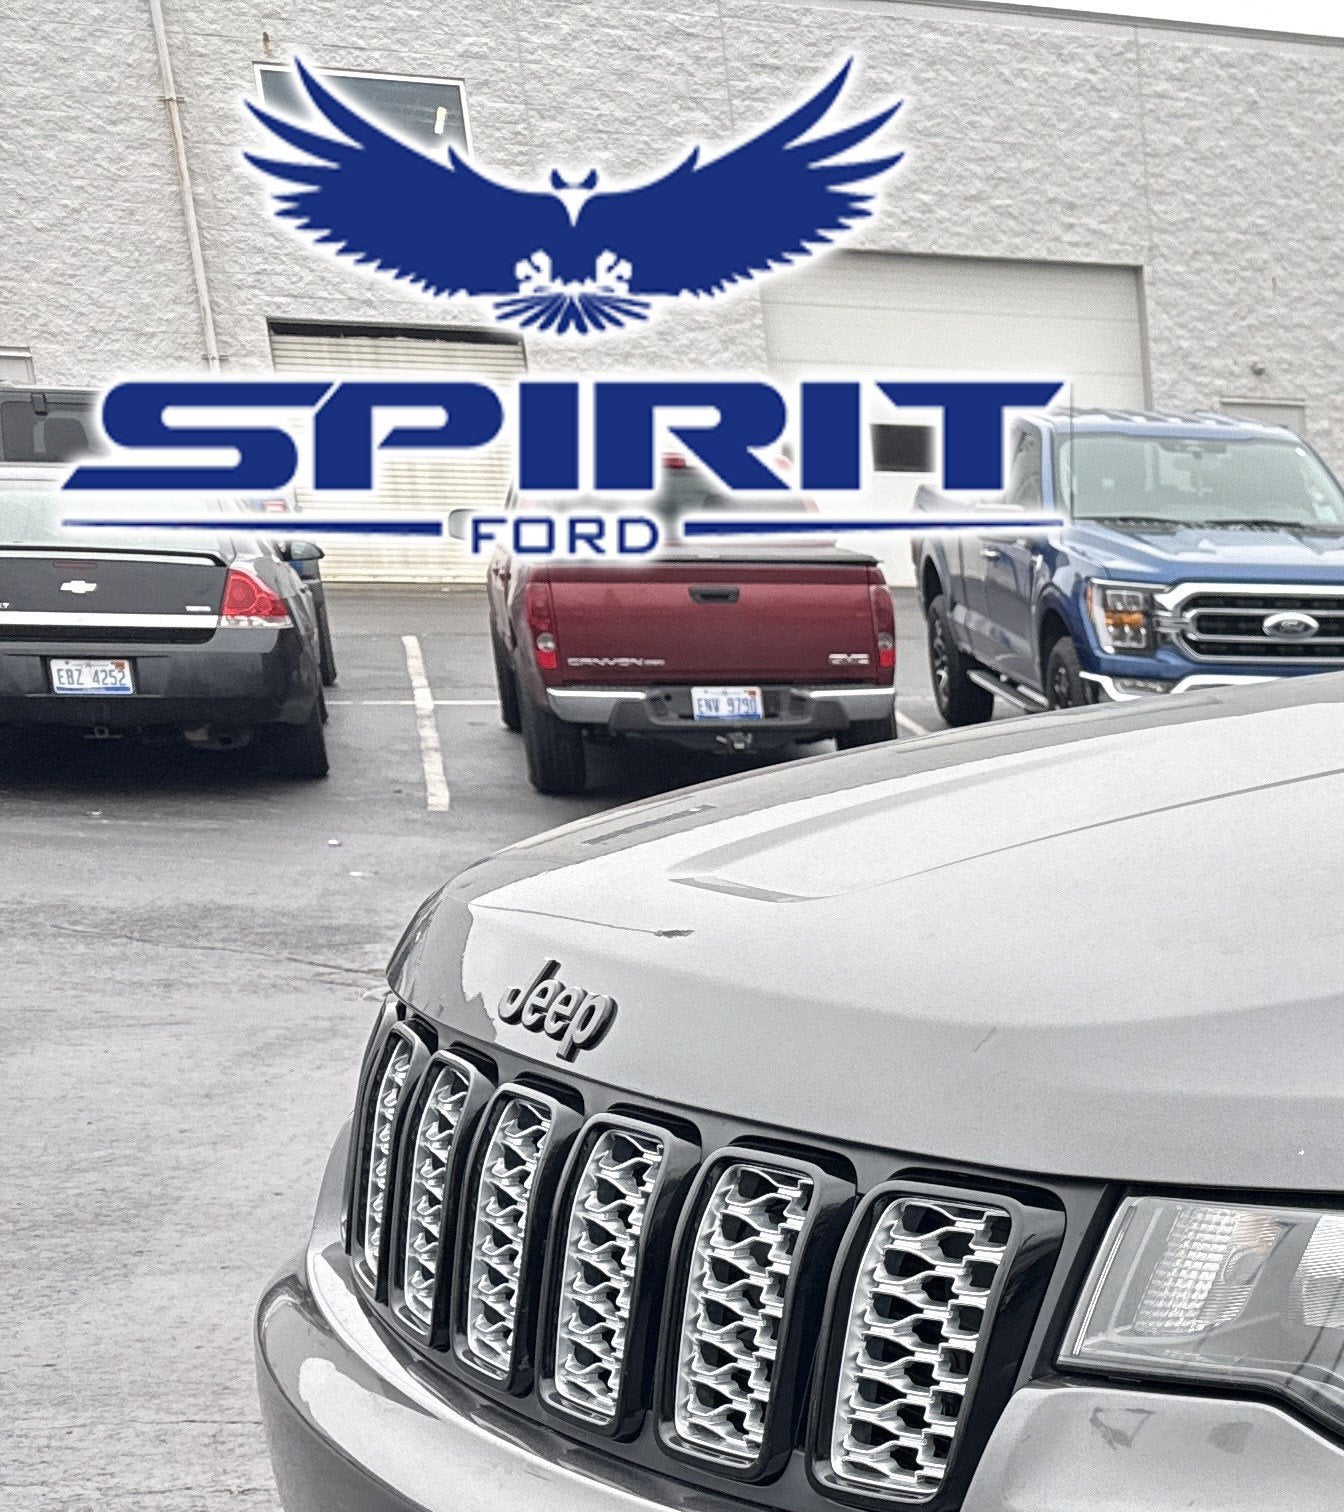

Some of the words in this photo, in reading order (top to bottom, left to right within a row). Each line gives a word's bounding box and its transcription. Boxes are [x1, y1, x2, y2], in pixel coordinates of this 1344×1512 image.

[56, 668, 84, 686] EBZ
[92, 669, 127, 686] 4252
[498, 957, 618, 1063] Jeep
